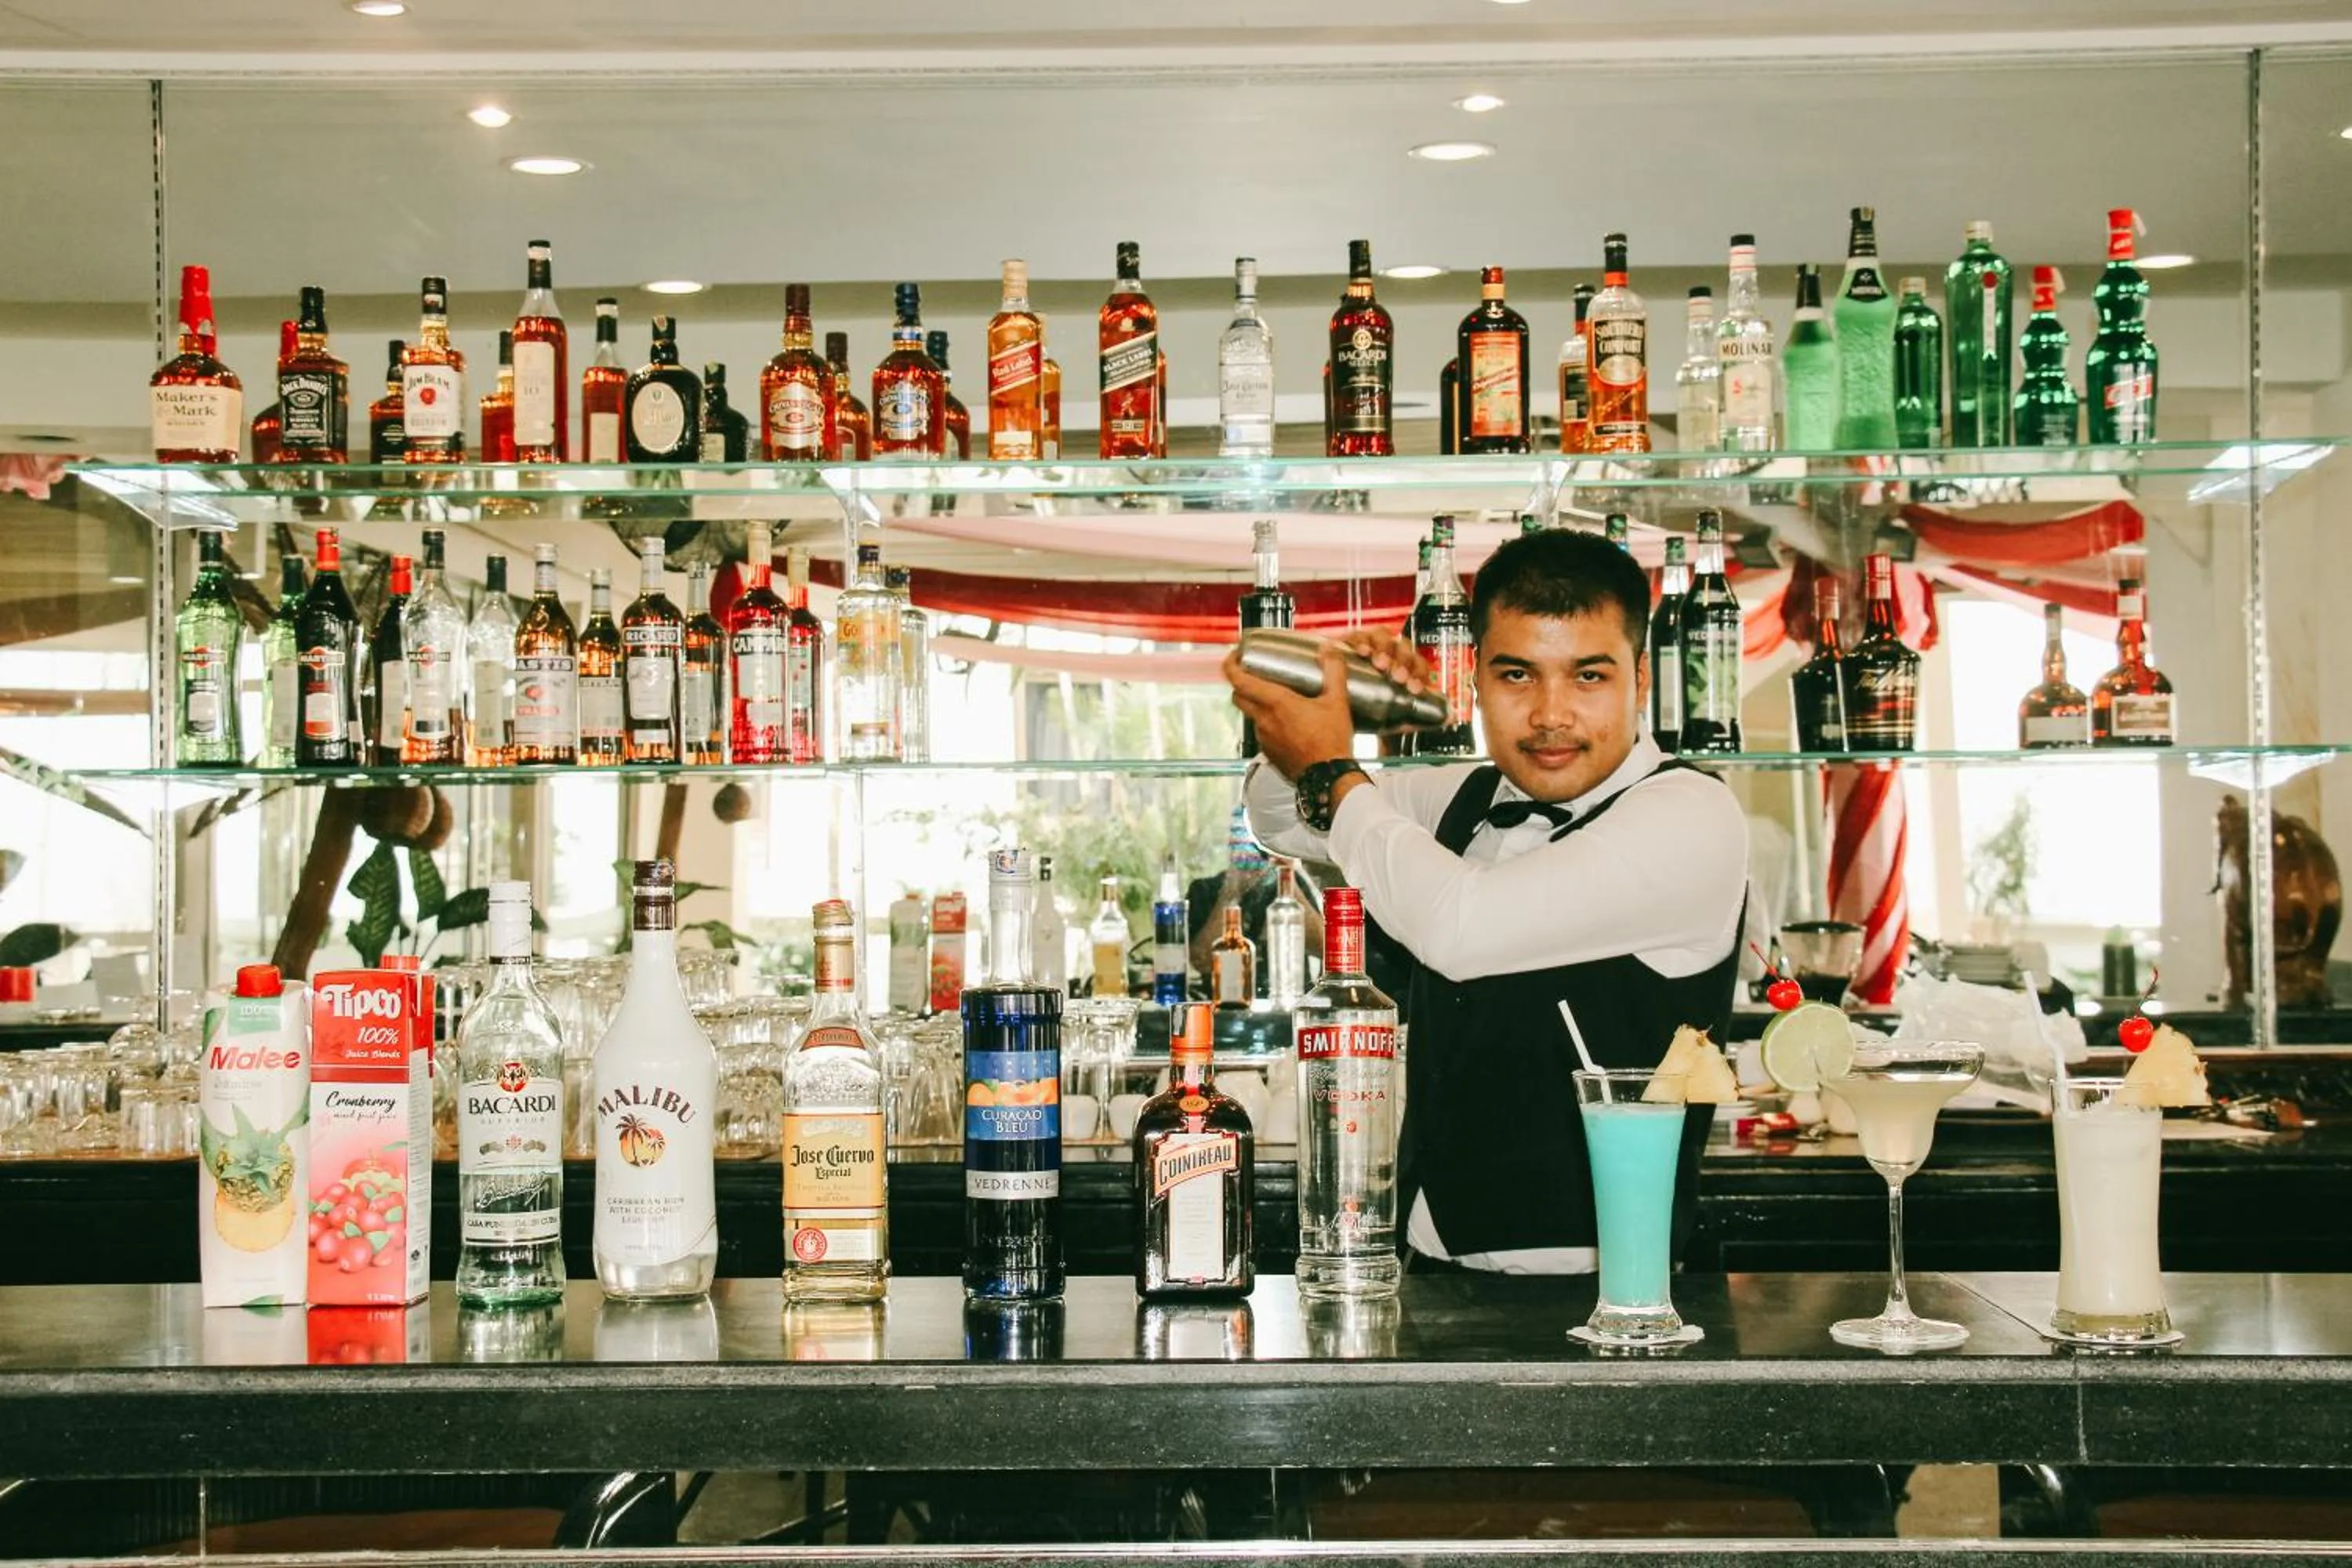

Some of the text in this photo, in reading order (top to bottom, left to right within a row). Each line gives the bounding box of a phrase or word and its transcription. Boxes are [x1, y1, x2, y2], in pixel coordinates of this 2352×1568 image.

[320, 982, 401, 1019] Tipco
[357, 1026, 400, 1044] 100%
[1304, 1031, 1394, 1054] SMIRNOFF
[209, 1046, 300, 1069] Malee
[325, 1091, 396, 1113] Cranberry
[468, 1094, 556, 1115] BACARDI
[597, 1084, 695, 1123] MALIBU
[1313, 1089, 1386, 1101] VODKA
[981, 1109, 1043, 1123] CURAÇAO
[996, 1121, 1029, 1134] BLEU
[789, 1144, 875, 1167] Jose Cuervo
[1160, 1144, 1232, 1186] COINTREAU
[815, 1166, 851, 1180] Especial
[975, 1178, 1051, 1191] VEDRENNE
